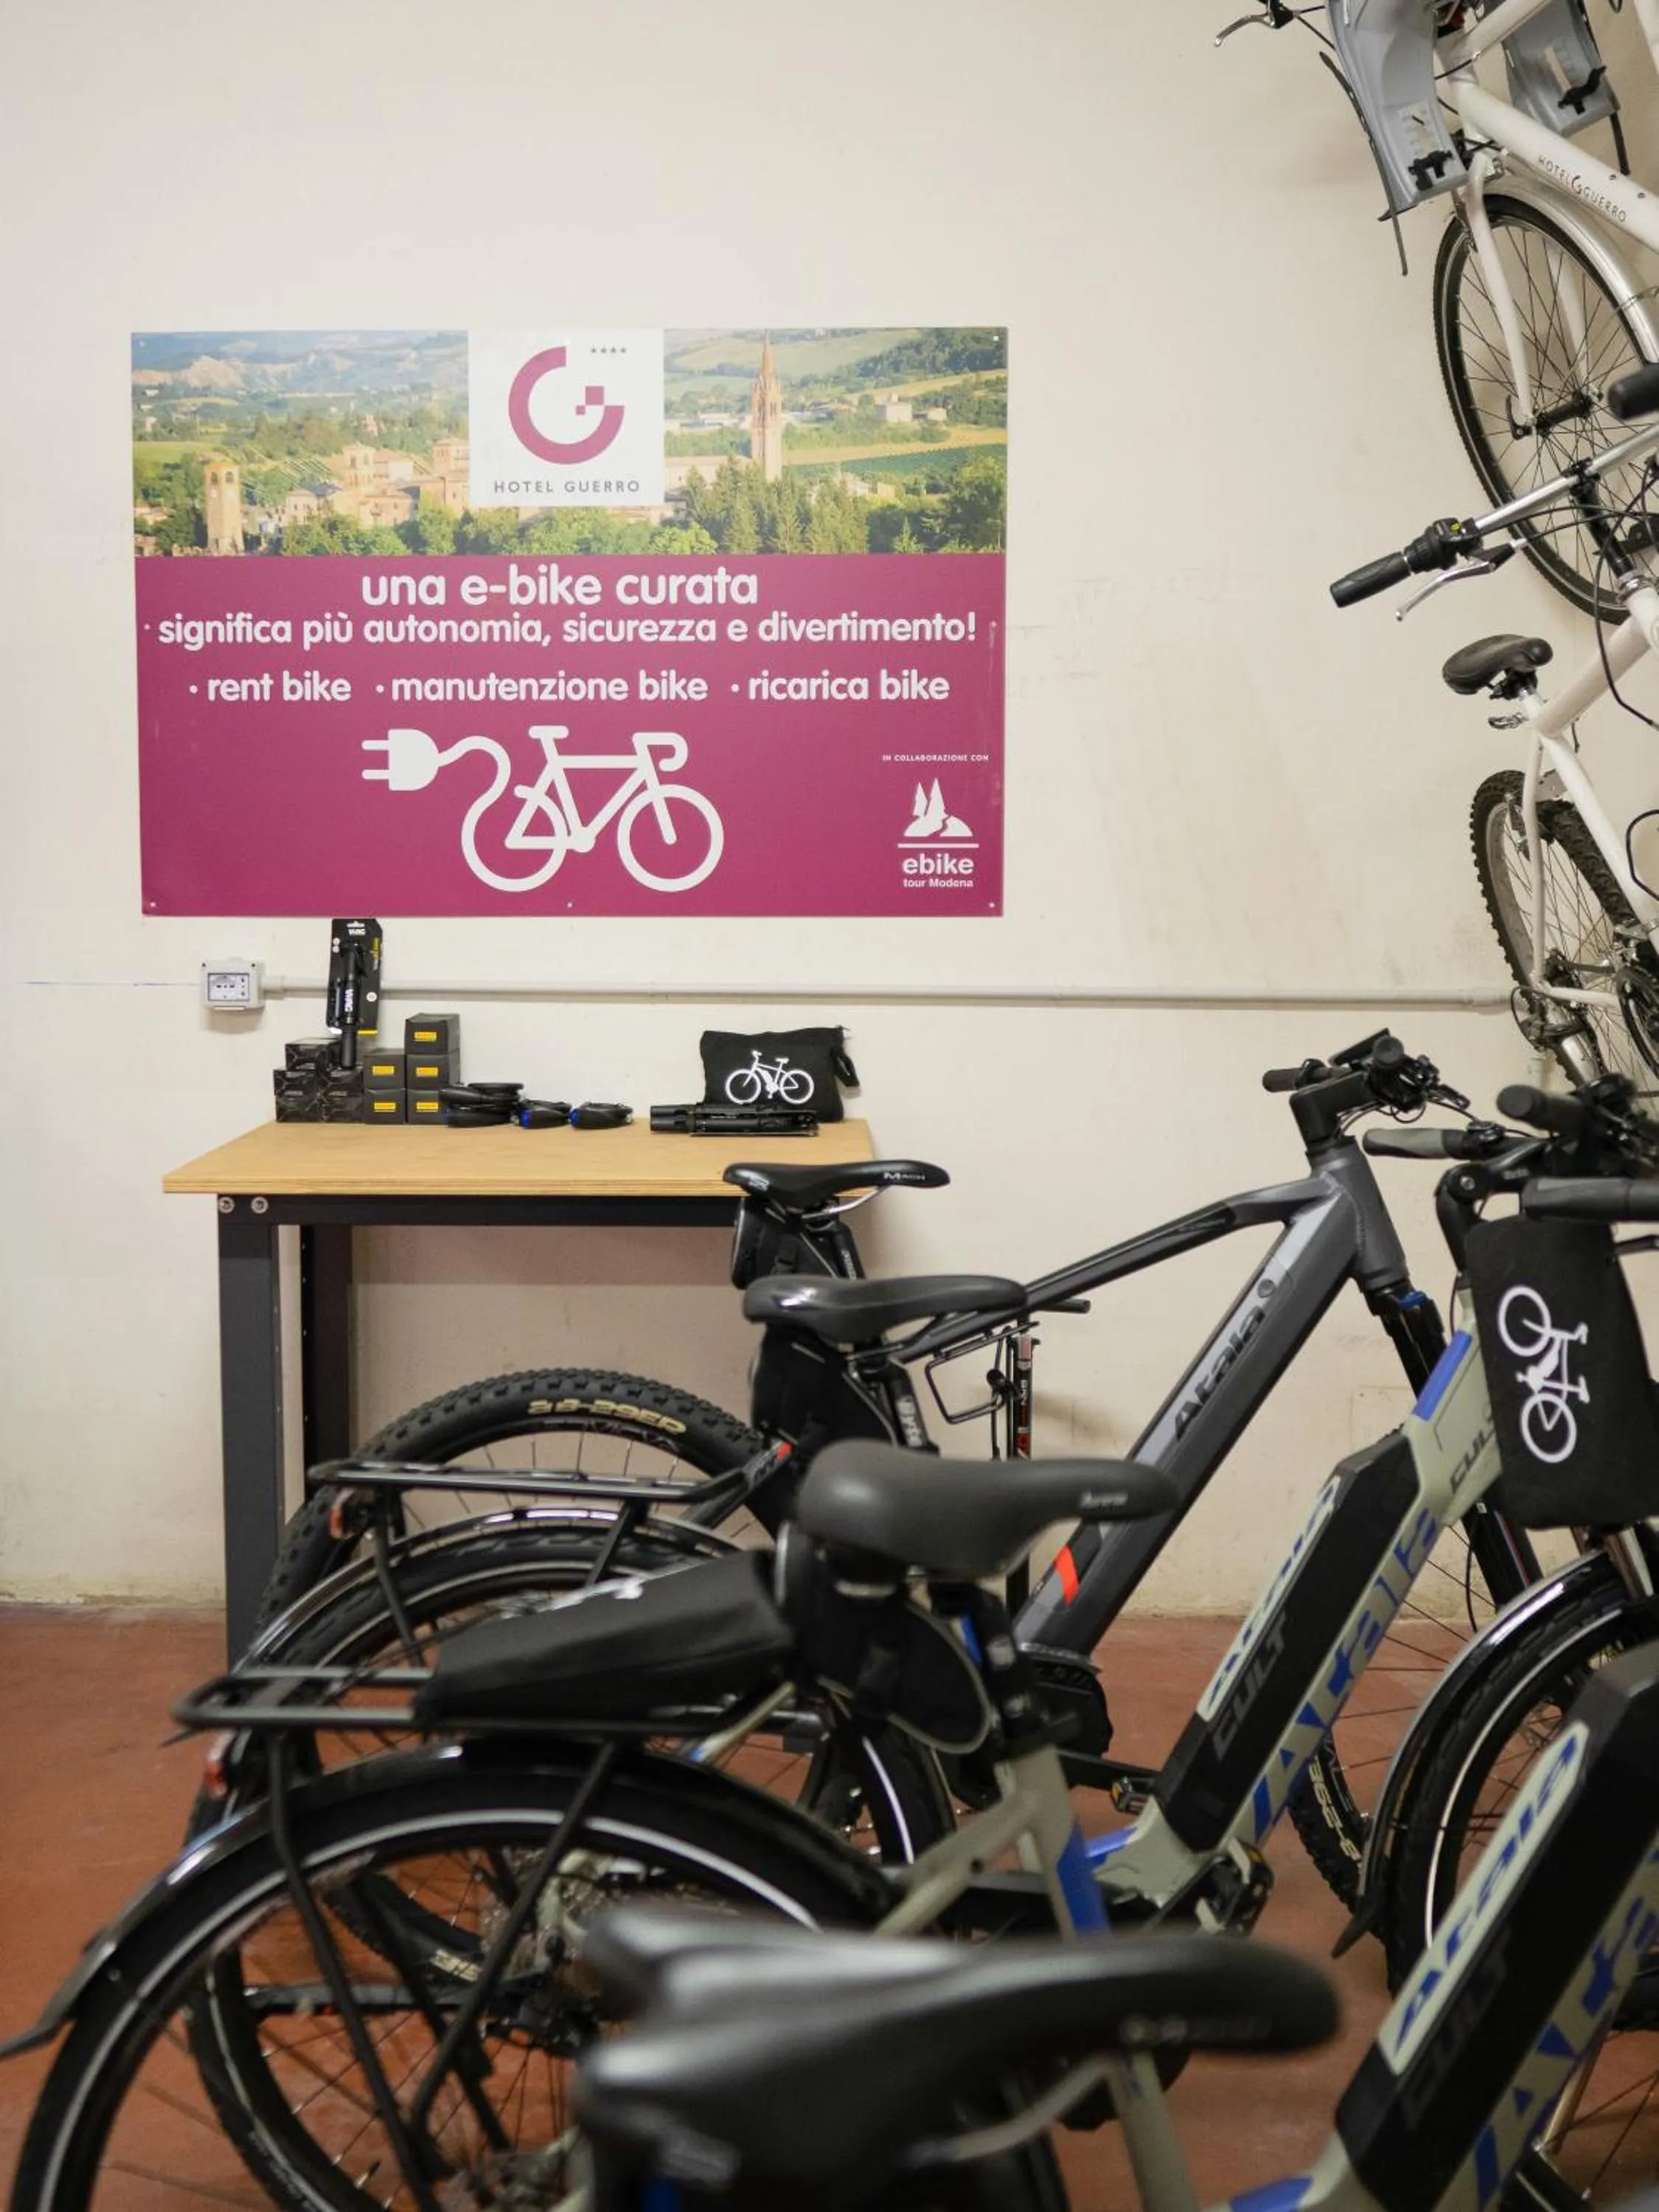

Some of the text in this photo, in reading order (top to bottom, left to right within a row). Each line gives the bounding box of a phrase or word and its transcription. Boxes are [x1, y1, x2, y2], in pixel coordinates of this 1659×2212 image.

[1538, 156, 1570, 185] HOTEL
[1583, 186, 1627, 223] GUERRO
[493, 480, 640, 493] HOTEL GUERRO
[361, 563, 758, 606] una e-bike curata
[159, 610, 975, 651] significa più autonomia, sicurezza e divertimento!
[207, 670, 352, 701] rent bike
[392, 669, 709, 701] manutenzione bike
[748, 669, 950, 700] ricarica bike
[902, 852, 974, 874] ebike
[903, 877, 974, 888] tour Modena
[1450, 1429, 1496, 1495] CUL
[1211, 1611, 1289, 1761] CULT
